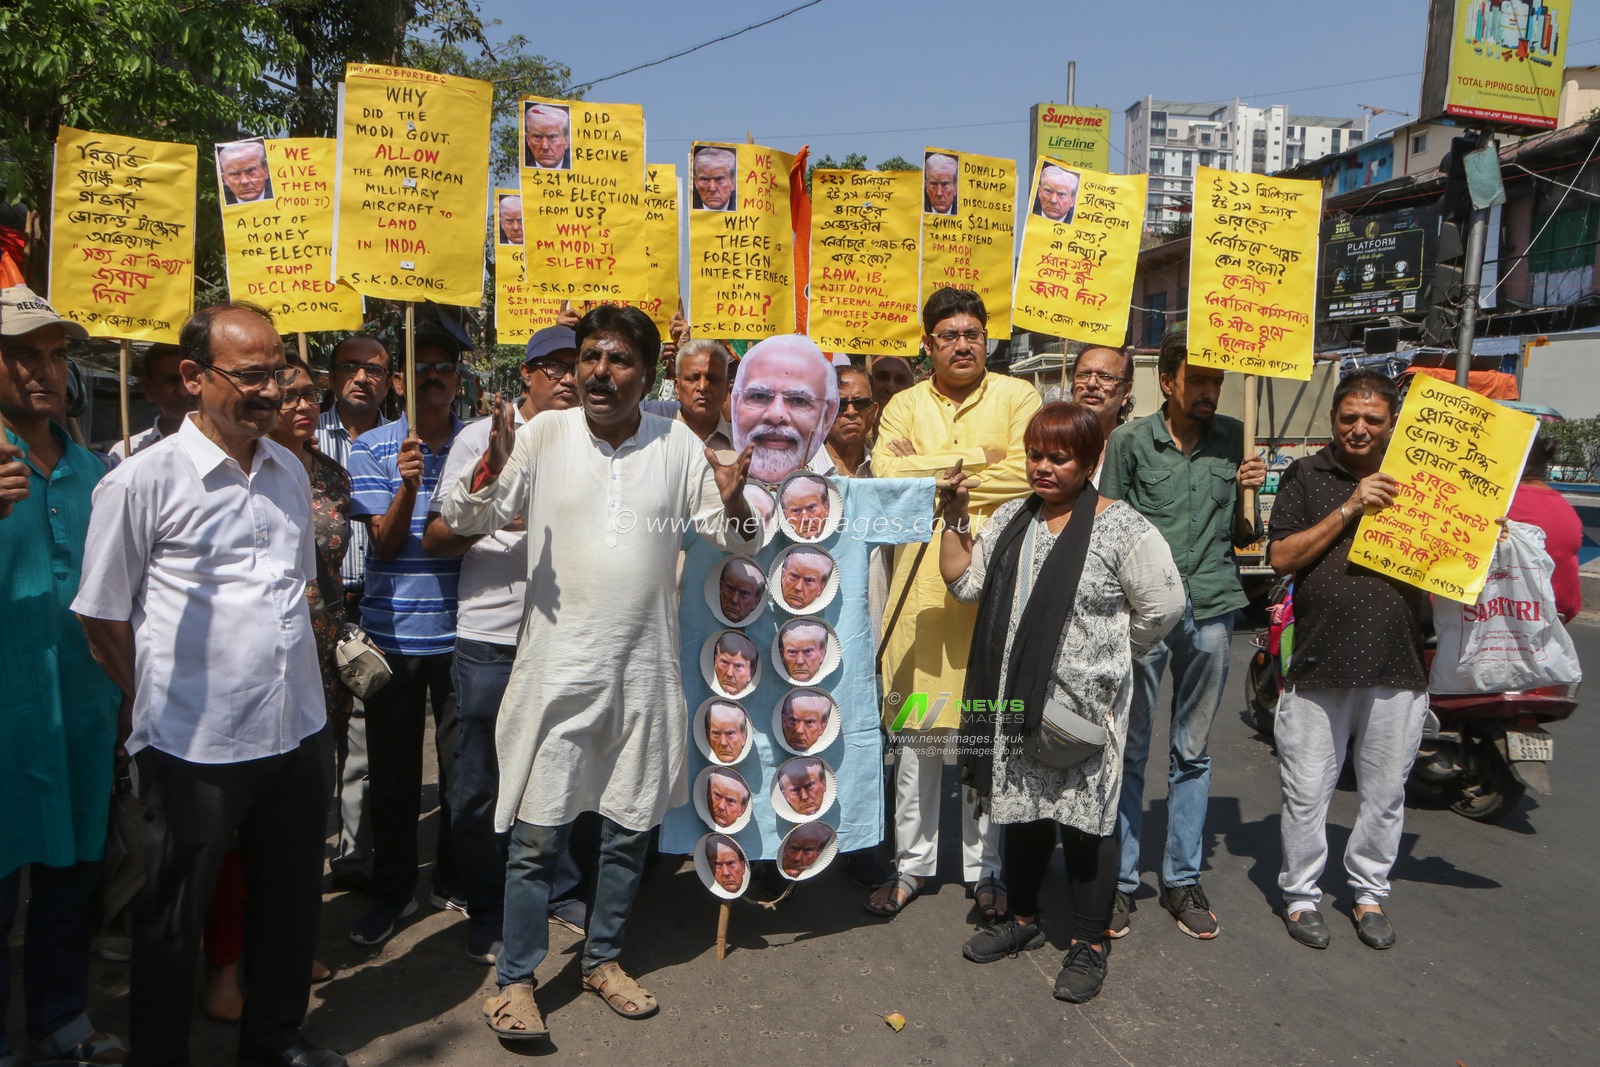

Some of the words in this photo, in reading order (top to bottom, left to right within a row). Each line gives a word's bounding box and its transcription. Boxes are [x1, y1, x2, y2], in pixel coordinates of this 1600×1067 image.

[349, 65, 380, 75] INDIAN
[385, 67, 446, 84] DEPORTEES
[1457, 76, 1483, 88] TOTAL
[1485, 80, 1513, 92] PIPING
[1514, 84, 1556, 97] SOLUTION
[385, 86, 428, 108] WHY
[363, 107, 384, 119] DID
[397, 111, 427, 122] THE
[584, 111, 610, 124] DID
[1042, 107, 1103, 128] Supreme
[356, 123, 394, 139] MODI
[406, 128, 450, 145] GOVT.
[577, 128, 622, 141] INDIA
[1048, 135, 1095, 149] Lifeline
[375, 143, 440, 164] ALLOW
[575, 148, 629, 162] RECIVE
[755, 153, 772, 169] WE
[277, 165, 317, 179] GIVE
[352, 167, 373, 177] THE
[383, 165, 463, 185] AMERICAN
[964, 162, 1006, 179] DONALD
[281, 181, 327, 192] THEM
[567, 173, 617, 187] MILLION
[746, 170, 778, 189] ASK
[969, 179, 1007, 193] TRUMP
[365, 182, 439, 200] MILLITARY
[542, 188, 564, 199] FOR
[570, 187, 639, 206] ELECTION
[275, 196, 309, 210] (MODI
[362, 200, 434, 216] AIRCRAFT
[439, 210, 452, 219] TO
[963, 198, 1012, 212] DISCLOSES
[237, 218, 246, 229] A
[252, 215, 281, 228] LOT
[291, 215, 308, 224] OF
[539, 206, 569, 216] FROM
[575, 206, 607, 226] US?
[724, 216, 760, 231] WHY
[933, 217, 963, 230] GIVING
[968, 213, 989, 231] $21
[378, 217, 417, 231] LAND
[556, 223, 592, 238] WHY
[247, 229, 309, 244] MONEY
[715, 235, 771, 250] THERE
[775, 243, 782, 251] IS
[942, 233, 957, 242] HIS
[961, 233, 993, 246] FRIEND
[1347, 236, 1396, 252] PLATFORM
[241, 248, 266, 257] FOR
[357, 239, 372, 250] IN
[385, 238, 431, 255] INDIA.
[536, 240, 555, 251] PM
[560, 240, 595, 254] MODI
[600, 242, 614, 255] JI
[932, 243, 945, 252] PM
[949, 245, 972, 257] MODI
[1050, 240, 1062, 251] না
[120, 254, 144, 267] না
[546, 256, 617, 276] SILENT?
[704, 251, 771, 268] FOREIGN
[954, 257, 971, 266] FOR
[265, 263, 313, 276] TRUMP
[823, 267, 859, 282] RAW,
[943, 267, 980, 281] VOTER
[92, 283, 135, 304] দিন
[247, 279, 336, 295] DECLARED
[820, 284, 845, 292] AJIT
[849, 285, 888, 299] DOVAL,
[717, 290, 761, 301] INDIAN
[716, 295, 772, 323] POLL?
[820, 295, 874, 307] EXTERNAL
[878, 301, 918, 313] AFFAIRS
[509, 308, 537, 316] VOTER
[823, 309, 868, 319] MINISTER
[871, 311, 908, 323] JABAB
[846, 320, 868, 333] DO?
[1209, 312, 1224, 328] কি
[1463, 597, 1541, 623] SABITRI
